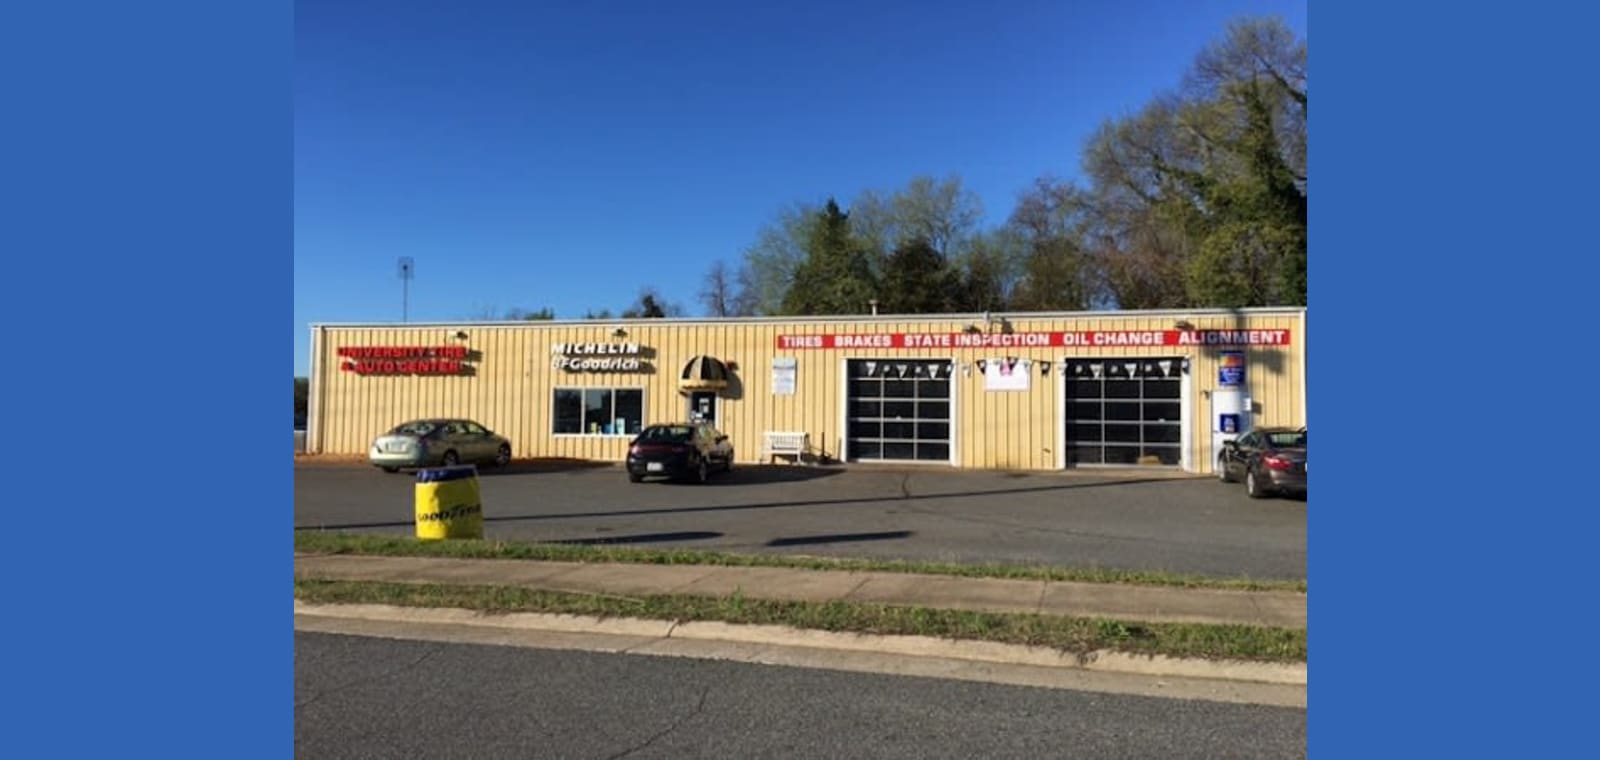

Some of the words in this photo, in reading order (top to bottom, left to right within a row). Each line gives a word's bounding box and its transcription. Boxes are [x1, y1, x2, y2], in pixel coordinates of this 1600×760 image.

[781, 335, 823, 347] TIRES
[834, 335, 892, 347] BRAKES
[903, 334, 951, 346] STATE
[955, 334, 1050, 346] INSPECTION
[1063, 333, 1090, 345] OIL
[1093, 332, 1164, 345] CHANGE
[1178, 331, 1286, 344] ALIGNMENT
[553, 343, 639, 354] MICHELIN
[355, 361, 395, 373] AUTO
[553, 357, 639, 369] BFGoodrich
